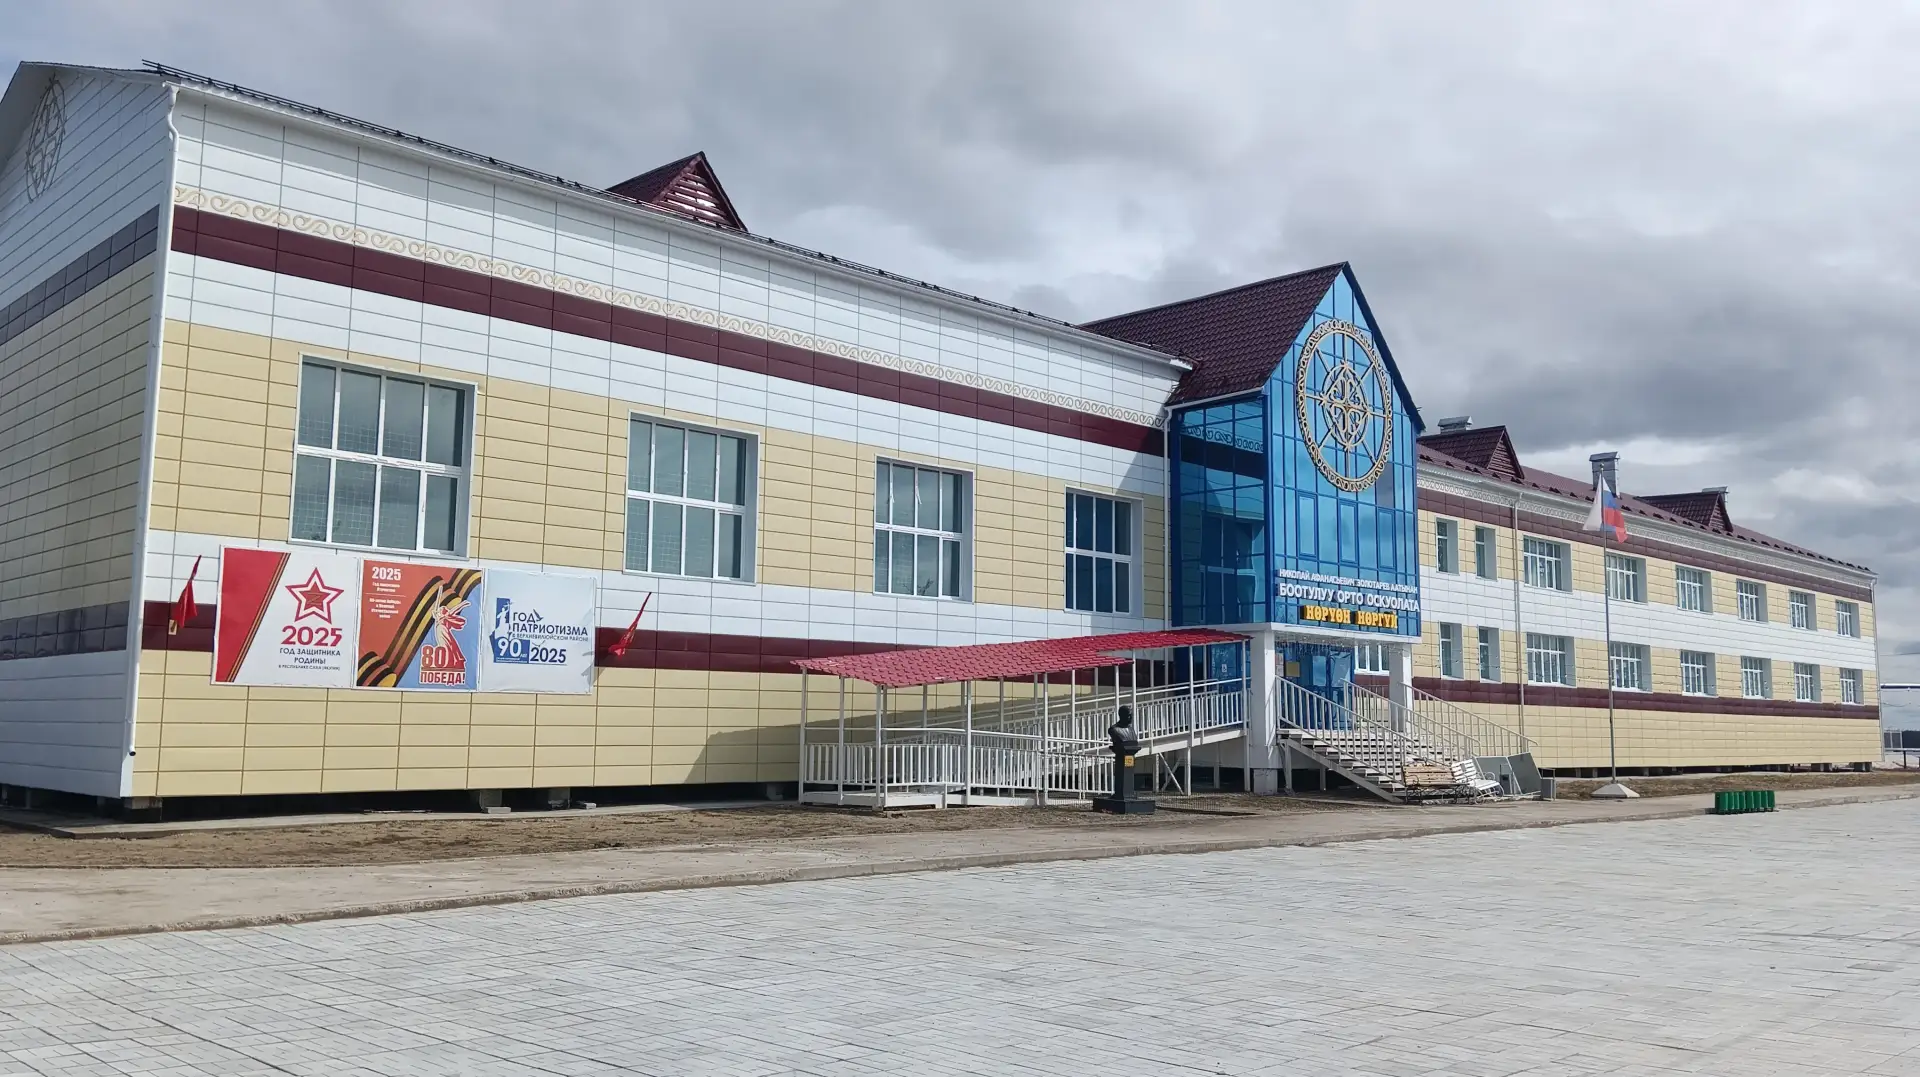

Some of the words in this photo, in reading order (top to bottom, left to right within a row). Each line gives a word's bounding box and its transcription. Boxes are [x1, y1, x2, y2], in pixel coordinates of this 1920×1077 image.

[372, 566, 402, 581] 2025
[1279, 568, 1310, 580] НИКОЛАЙ
[1311, 573, 1355, 586] АФАНАСЬЕВИЧ
[1355, 579, 1390, 591] ЗОЛОТАРЕВ
[1279, 583, 1335, 601] БООТУЛУУ
[1337, 590, 1364, 606] ОРТО
[1367, 593, 1420, 612] ОСКУОЛАТА
[512, 612, 536, 623] ГОД
[281, 625, 343, 647] 2025
[512, 623, 588, 636] ПАТРИОТИЗМА
[280, 647, 296, 656] ГОД
[297, 648, 341, 657] ЗАЩИТНИКА
[498, 637, 522, 658] 90
[530, 647, 567, 663] 2025
[294, 656, 326, 664] РОДИНЫ
[421, 645, 449, 668] 80
[420, 671, 466, 685] ПОБЕДА!
